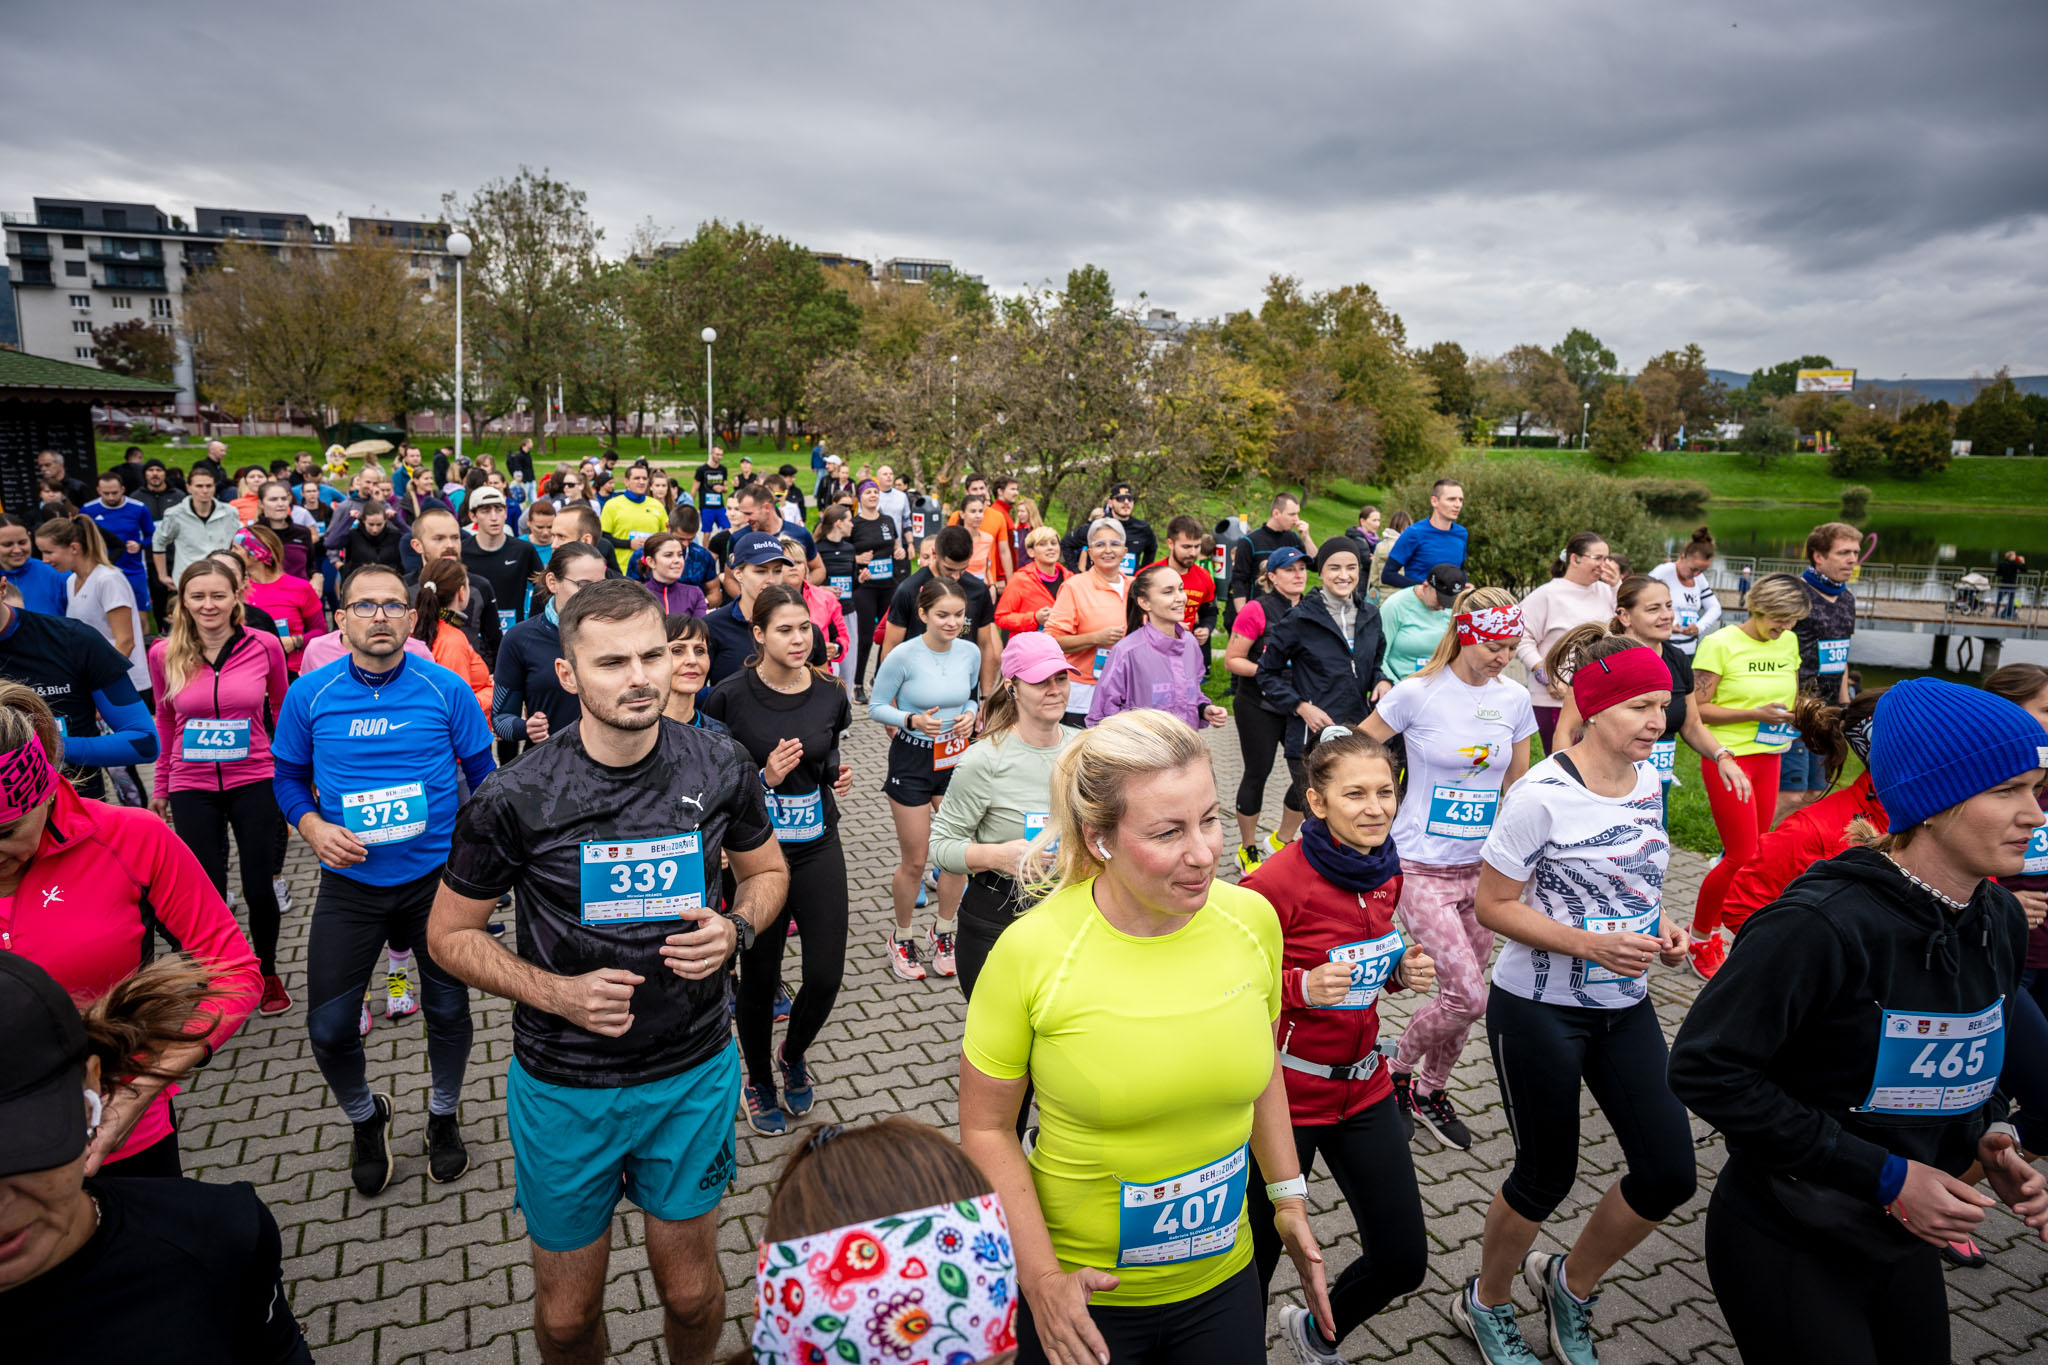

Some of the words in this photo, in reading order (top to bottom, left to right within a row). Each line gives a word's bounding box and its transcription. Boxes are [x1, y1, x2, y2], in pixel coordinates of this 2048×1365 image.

[1828, 648, 1847, 662] 309
[1748, 661, 1775, 672] RUN
[348, 717, 388, 736] RUN
[197, 730, 236, 746] 443
[1649, 752, 1675, 768] 358
[361, 800, 409, 826] 373
[777, 806, 815, 825] 375
[1445, 802, 1485, 822] 435
[651, 844, 666, 853] BEH
[610, 860, 678, 893] 339
[1350, 955, 1391, 986] 352
[1908, 1038, 1988, 1078] 465
[1200, 1170, 1216, 1183] BEH
[1153, 1183, 1228, 1235] 407
